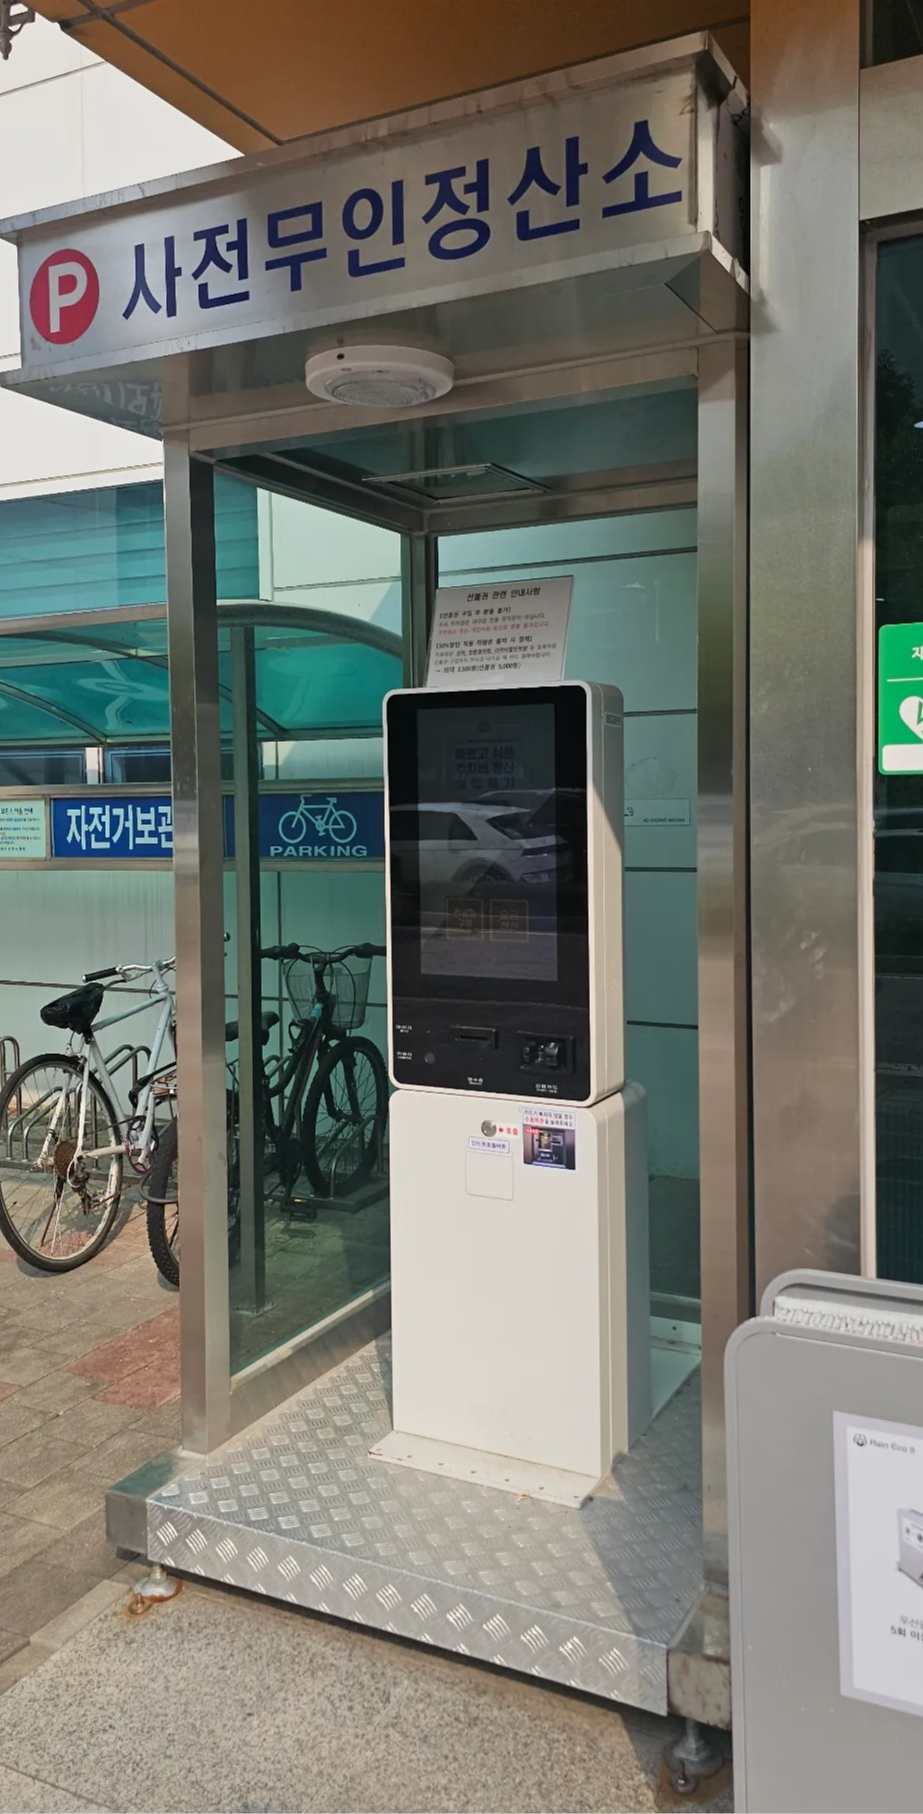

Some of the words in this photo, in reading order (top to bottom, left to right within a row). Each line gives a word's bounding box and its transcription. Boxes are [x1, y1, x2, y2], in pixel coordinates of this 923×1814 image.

[48, 261, 88, 333] P
[122, 119, 683, 320] 사전무인정산소
[467, 592, 488, 602] 선불권
[492, 590, 507, 600] 관련
[510, 587, 541, 598] 안내사항
[270, 845, 368, 857] PARKING
[506, 1127, 519, 1136] 호출
[870, 1438, 889, 1450] Rain
[891, 1442, 908, 1453] Eco
